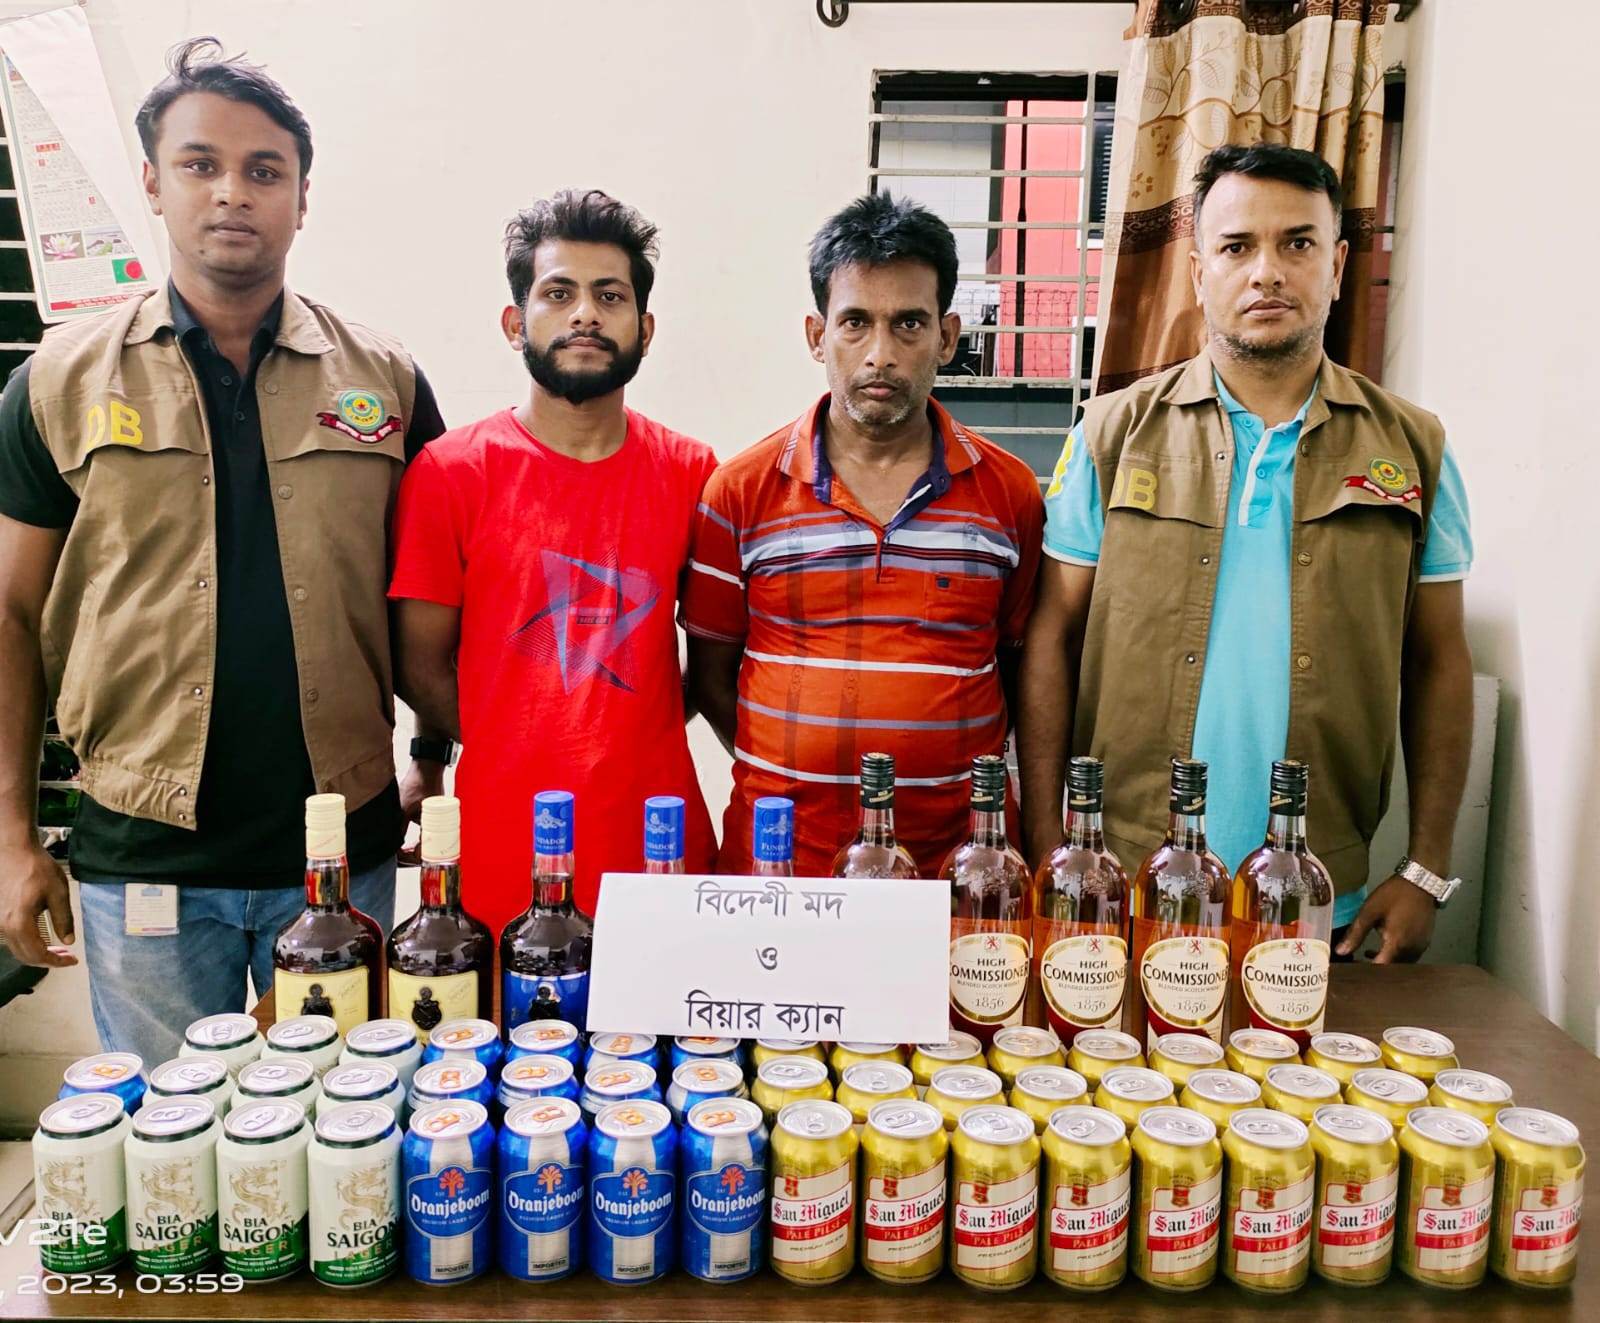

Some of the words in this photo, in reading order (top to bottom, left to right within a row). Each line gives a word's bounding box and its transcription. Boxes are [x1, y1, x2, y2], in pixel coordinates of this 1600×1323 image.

[695, 881, 793, 917] বিদেশী
[801, 890, 847, 920] মদ
[756, 947, 778, 971] ও
[977, 958, 1006, 967] HIGH
[1080, 960, 1108, 969] HIGH
[1180, 961, 1209, 971] HIGH
[1283, 963, 1313, 972] HIGH
[950, 961, 1029, 982] OMMISSIONER
[684, 989, 765, 1031] বিয়ার
[775, 1002, 845, 1035] ক্যান
[411, 1189, 489, 1219] Oranjeboom
[595, 1190, 672, 1219] Oranjeboom
[691, 1187, 766, 1216] Oranjeboom
[774, 1202, 797, 1221] San
[799, 1190, 849, 1221] Miguel
[869, 1203, 896, 1222] San
[898, 1186, 944, 1221] Miguel
[959, 1208, 985, 1228] San
[988, 1194, 1035, 1228] Miguel
[135, 1215, 208, 1241] SAIGON
[157, 1214, 181, 1225] BIA
[243, 1217, 268, 1228] BIA
[353, 1218, 377, 1231] BIA
[1056, 1213, 1085, 1231] San
[1155, 1215, 1186, 1232] San
[1240, 1215, 1271, 1233] San
[1327, 1209, 1358, 1228] San
[1424, 1213, 1456, 1230] San
[1521, 1215, 1554, 1232] San
[223, 1220, 294, 1243] SAIGON
